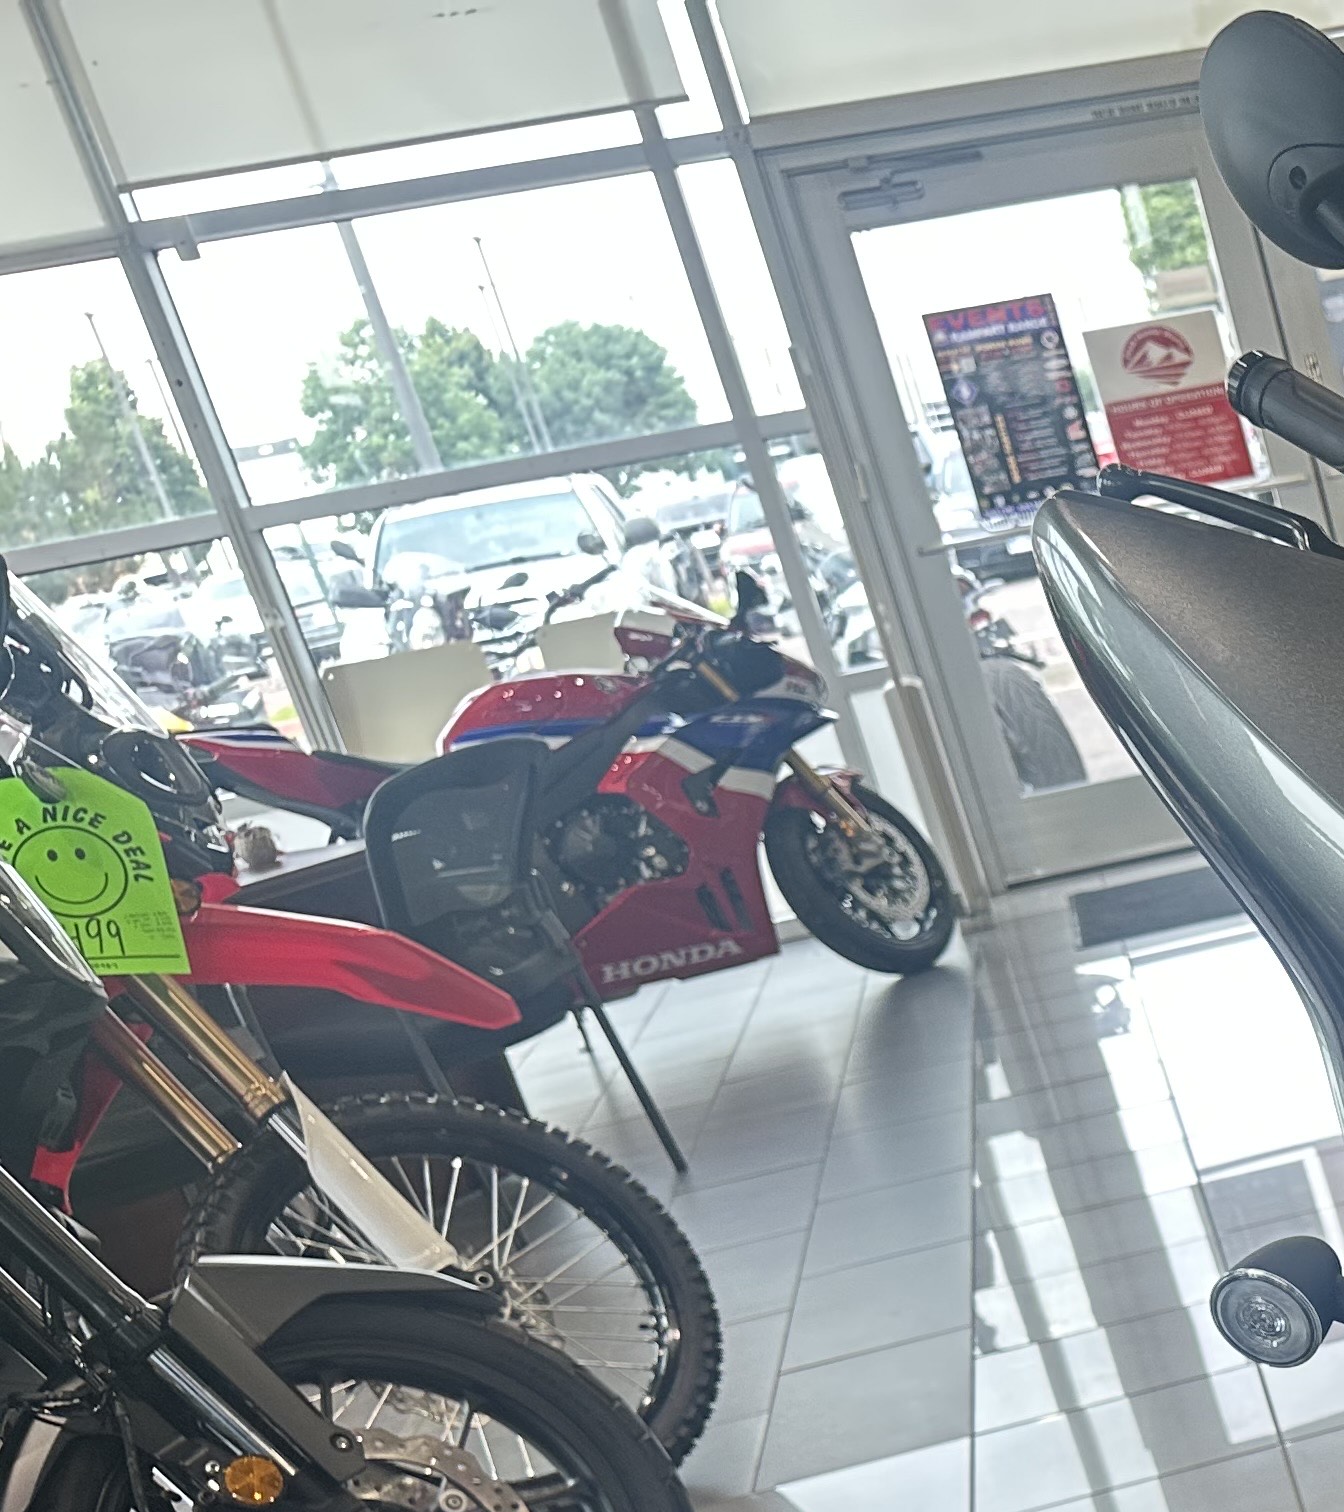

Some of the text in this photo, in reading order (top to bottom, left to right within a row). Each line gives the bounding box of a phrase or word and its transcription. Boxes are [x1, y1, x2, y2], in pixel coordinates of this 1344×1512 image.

[14, 805, 154, 884] A NICE DEAL
[600, 938, 743, 984] HONDA
